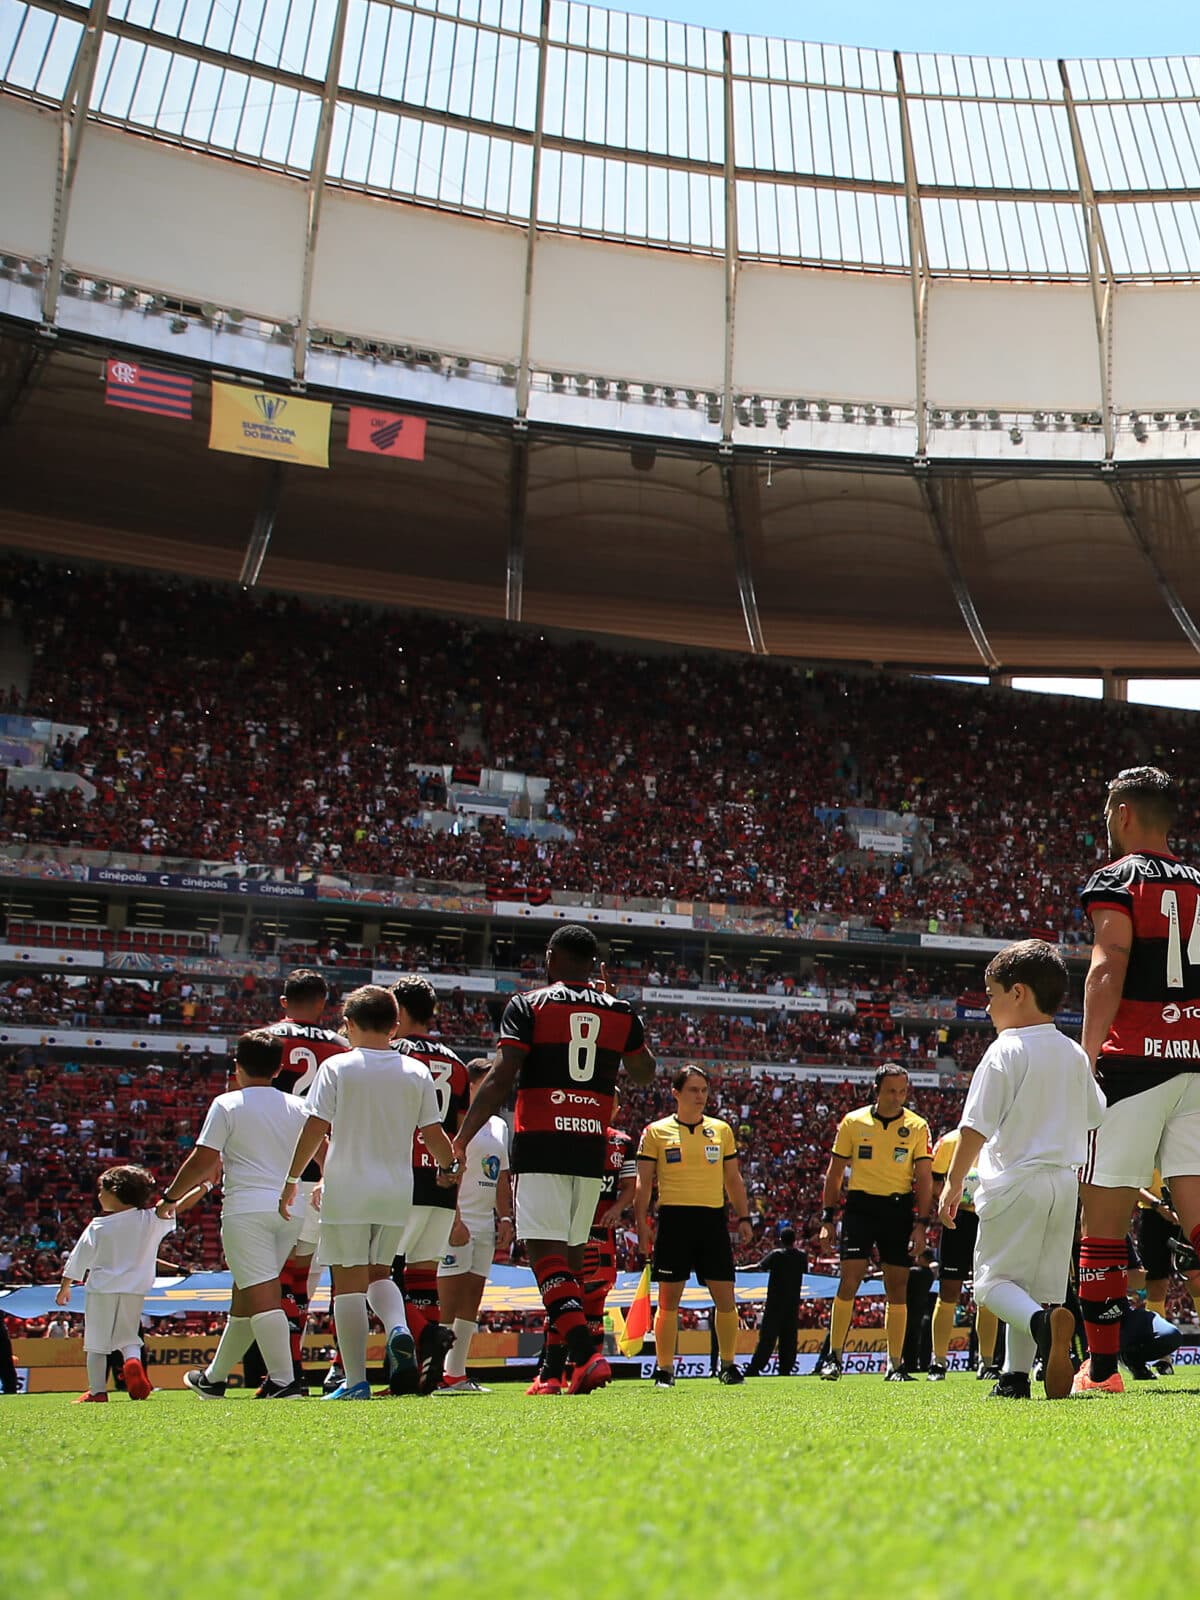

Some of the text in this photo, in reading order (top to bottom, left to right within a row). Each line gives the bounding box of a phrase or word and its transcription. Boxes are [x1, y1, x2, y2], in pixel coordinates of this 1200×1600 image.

[242, 421, 296, 437] SUPERCOPA
[244, 430, 292, 444] DO BRASIL
[99, 870, 147, 884] cinépolis
[181, 877, 228, 891] cinépolis
[568, 1012, 601, 1082] 8
[1144, 1037, 1162, 1057] DE
[289, 1047, 318, 1097] 2
[554, 1116, 602, 1134] GERSON
[150, 1348, 216, 1364] UPERC
[643, 1363, 705, 1376] SRTS
[842, 1360, 887, 1372] SPORT
